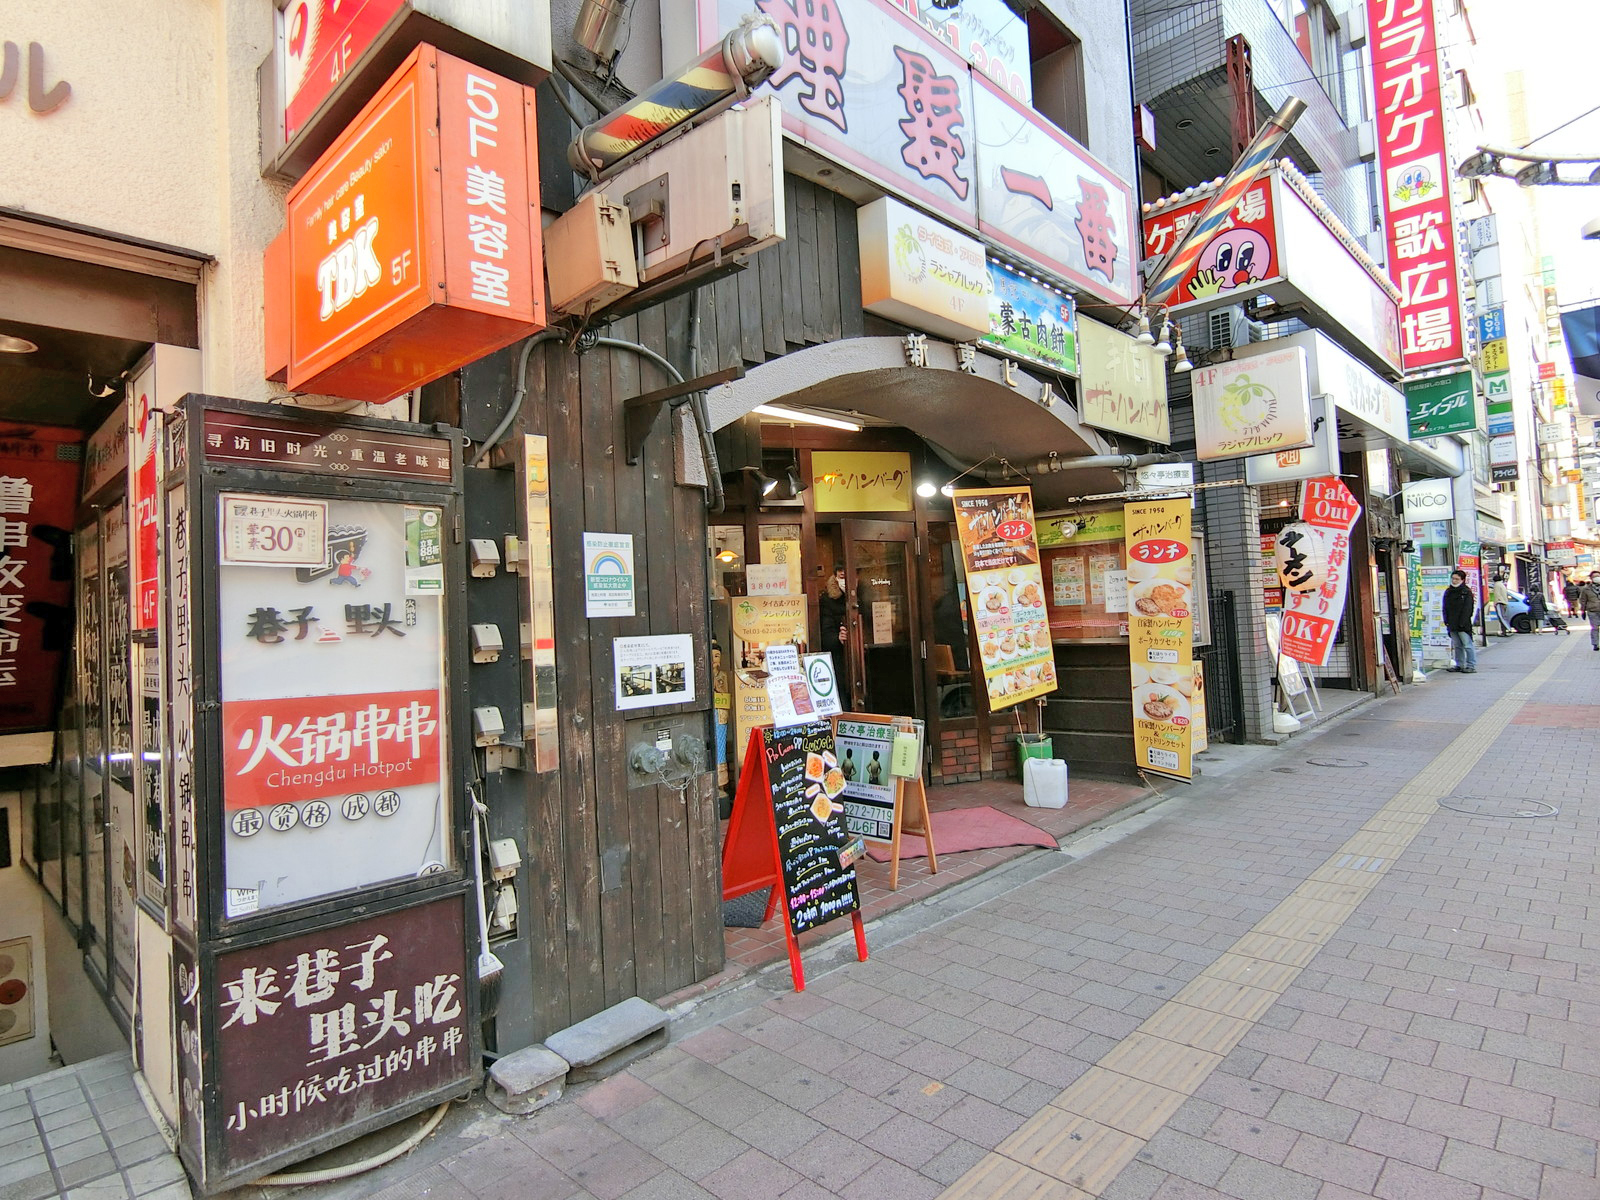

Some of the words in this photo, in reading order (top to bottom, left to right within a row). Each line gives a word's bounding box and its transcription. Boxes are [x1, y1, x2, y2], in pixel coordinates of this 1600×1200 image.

[330, 33, 353, 84] 4F
[466, 73, 498, 158] 5F
[466, 165, 511, 307] 美容室
[318, 216, 382, 322] TBK
[392, 249, 412, 286] 5F
[930, 259, 984, 294] ラジャプルック
[1394, 211, 1452, 355] 歌広場
[950, 295, 965, 313] 4F
[1060, 306, 1070, 321] 5F
[1000, 300, 1066, 356] 蒙古肉餅
[1484, 312, 1495, 339] NOVA
[902, 332, 1057, 406] 新東ビル
[1195, 368, 1218, 388] 4F
[1410, 390, 1469, 420] エイブル
[1218, 432, 1283, 451] ラジャプルック
[1140, 469, 1190, 480] 悠々亭治療室
[1493, 468, 1517, 478] アライビル
[961, 500, 975, 508] SINCE
[1308, 481, 1358, 508] Take
[1406, 493, 1447, 510] NICO
[1315, 500, 1349, 522] Out
[260, 525, 294, 552] 30
[1003, 523, 1026, 537] ランチ
[1138, 543, 1180, 559] ランチ
[1279, 530, 1314, 588] ラーメン
[1317, 532, 1349, 615] お持ち帰り
[142, 588, 156, 620] 4F
[246, 605, 320, 644] 巷子
[344, 602, 407, 638] 里头
[1137, 618, 1183, 629] 自家製ハンバーグ
[1283, 615, 1331, 643] OK!
[1138, 637, 1183, 647] ポークカツセット
[236, 700, 438, 776] 火锅串串
[1138, 720, 1187, 734] 自家製ハンバーグ
[802, 735, 834, 752] LUNCH
[266, 769, 346, 789] Chengdu
[353, 757, 413, 780] Hotpot
[345, 792, 399, 818] 成都
[220, 934, 394, 1030] 来巷子
[306, 974, 463, 1068] 里头吃
[226, 1026, 464, 1131] 小时候吃过的串串
